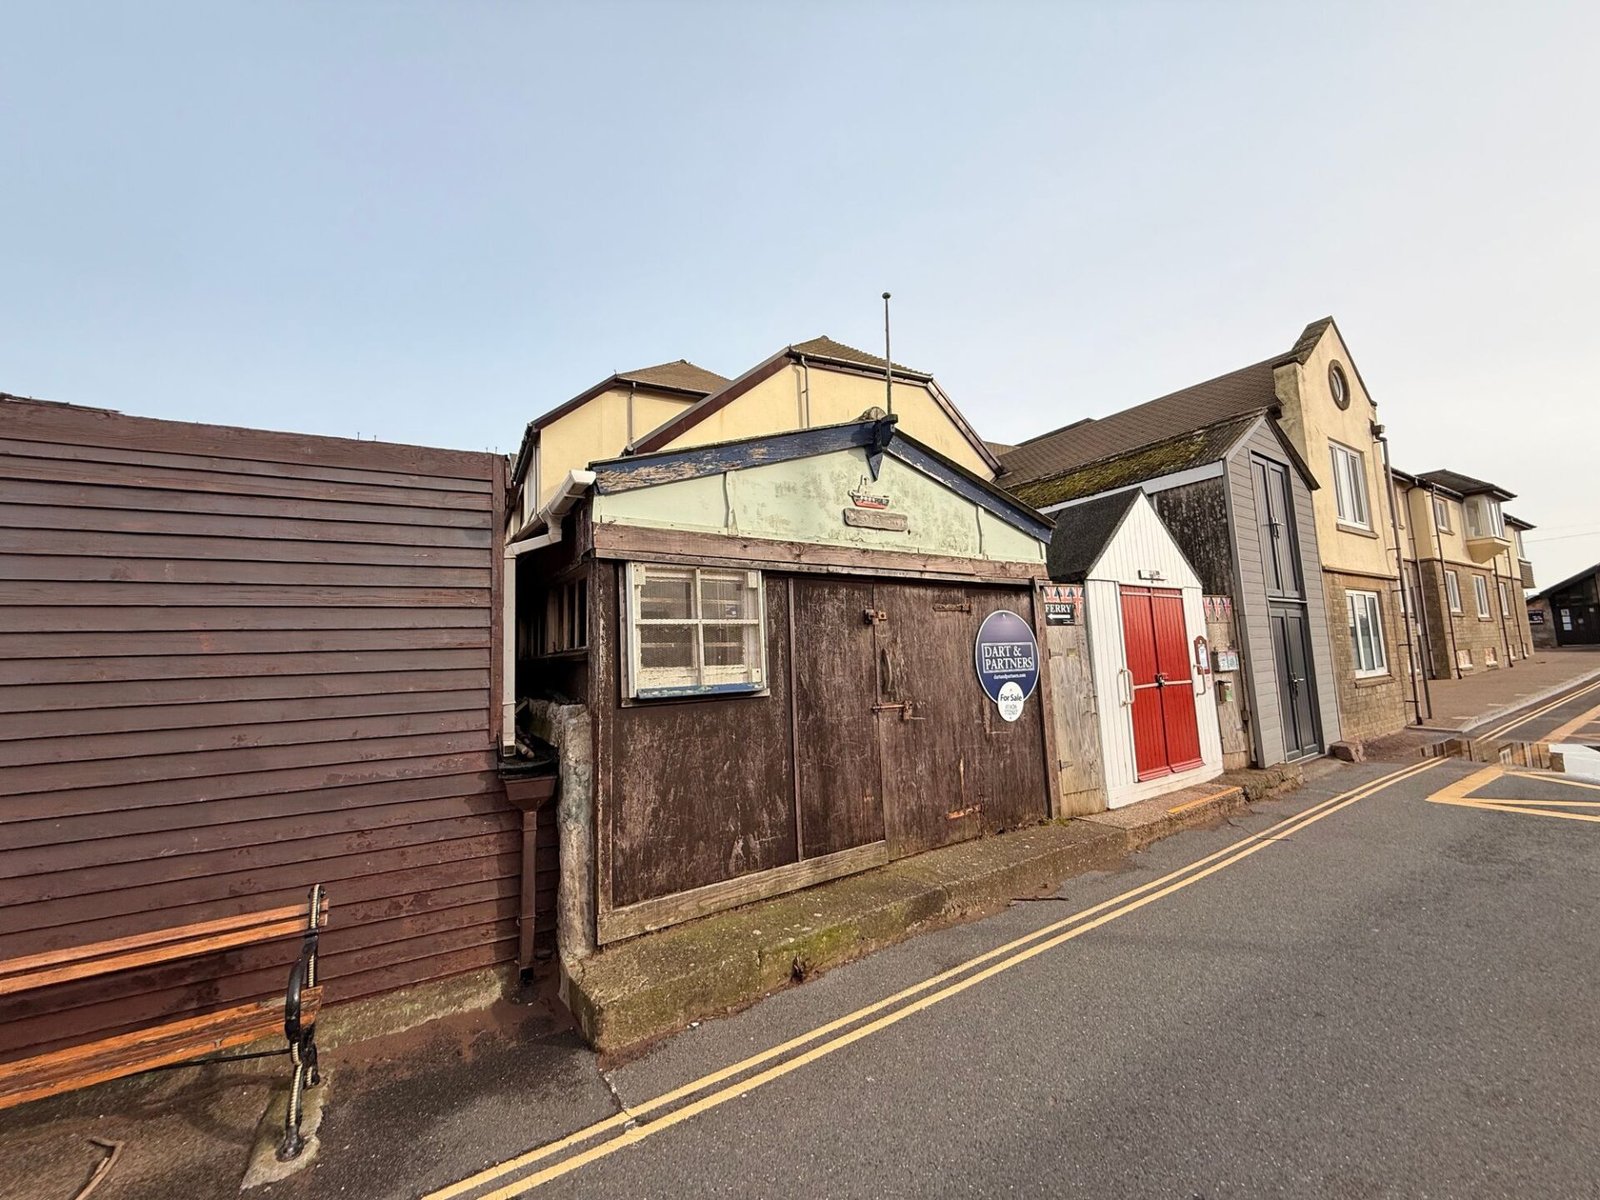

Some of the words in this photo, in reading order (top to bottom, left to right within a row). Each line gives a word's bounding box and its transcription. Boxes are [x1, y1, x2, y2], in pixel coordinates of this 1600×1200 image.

[1045, 604, 1071, 613] FERRY
[985, 646, 1010, 657] DART
[1013, 646, 1021, 656] &
[985, 657, 1032, 670] PARTNERS
[1000, 694, 1010, 702] For
[1010, 693, 1022, 702] Sale
